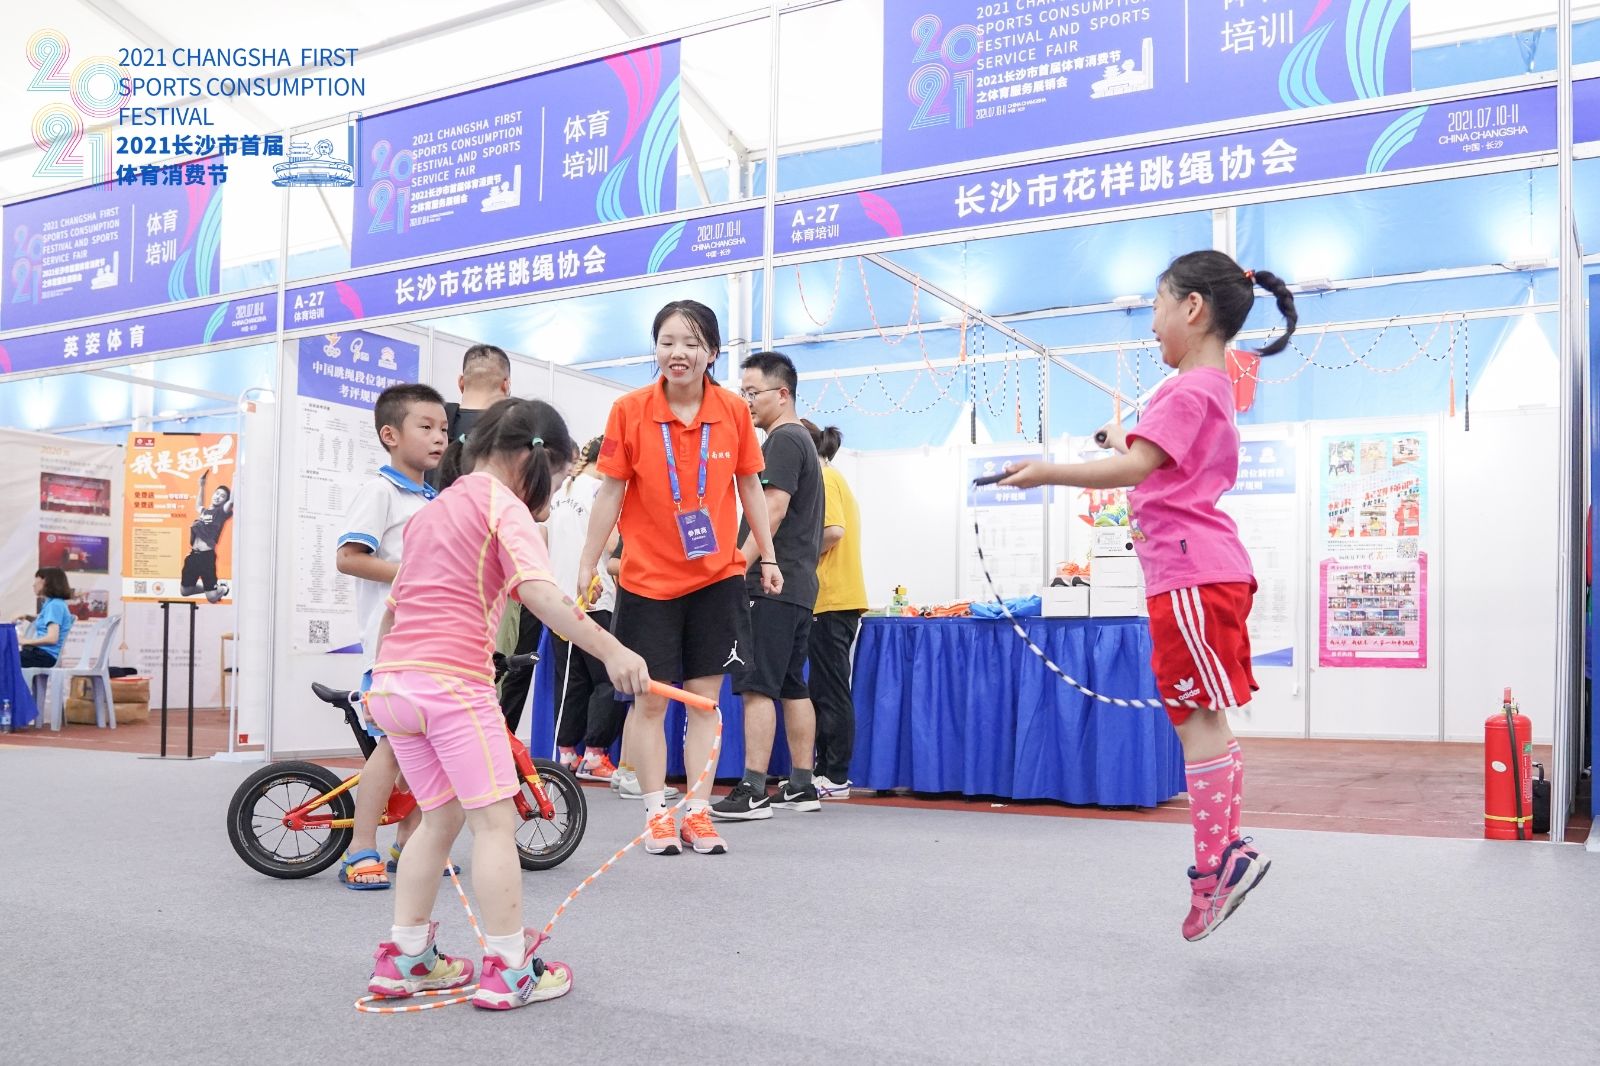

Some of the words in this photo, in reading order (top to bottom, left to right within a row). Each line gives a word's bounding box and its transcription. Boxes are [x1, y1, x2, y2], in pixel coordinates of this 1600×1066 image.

[976, 2, 1010, 20] 2021
[977, 14, 1034, 36] SPORTS
[977, 30, 1043, 54] FESTIVAL
[1049, 22, 1080, 39] AND
[1090, 8, 1151, 31] SPORTS
[1220, 9, 1294, 54] 培训
[976, 47, 1036, 71] SERVICE
[1046, 40, 1079, 57] FAIR
[412, 132, 434, 146] 2021
[437, 119, 490, 140] CHANGSHA
[494, 110, 523, 126] FIRST
[563, 109, 611, 145] 体育
[1448, 103, 1519, 132] 2021.07.10-11
[412, 143, 448, 160] SPORTS
[451, 126, 523, 151] CONSUMPTION
[1438, 133, 1470, 145] CHINA
[1470, 125, 1528, 142] CHANGSHA
[412, 156, 454, 173] FESTIVAL
[457, 150, 477, 163] AND
[482, 141, 521, 158] SPORTS
[562, 145, 609, 180] 培训
[411, 170, 449, 188] SERVICE
[455, 164, 476, 179] FAIR
[954, 138, 1298, 218] 长沙市花样跳绳协会
[60, 211, 97, 228] CHANGSHA
[99, 206, 119, 219] FIRST
[146, 208, 179, 238] 体育
[792, 203, 840, 227] A-27
[42, 229, 68, 243] SPORTS
[74, 237, 89, 249] AND
[91, 231, 119, 245] SPORTS
[691, 242, 711, 252] CHINA
[710, 236, 746, 249] CHANGSHA
[791, 223, 840, 245] 体育培训
[42, 252, 70, 267] SERVICE
[72, 249, 88, 261] FAIR
[145, 238, 177, 266] 培训
[395, 244, 607, 305] 长沙市花样跳绳协会
[294, 290, 325, 309] A-27
[293, 307, 325, 323] 体育培训
[63, 324, 146, 359] 英姿体育
[312, 360, 406, 390] 中国跳绳段位制
[1178, 687, 1201, 701] adidas
